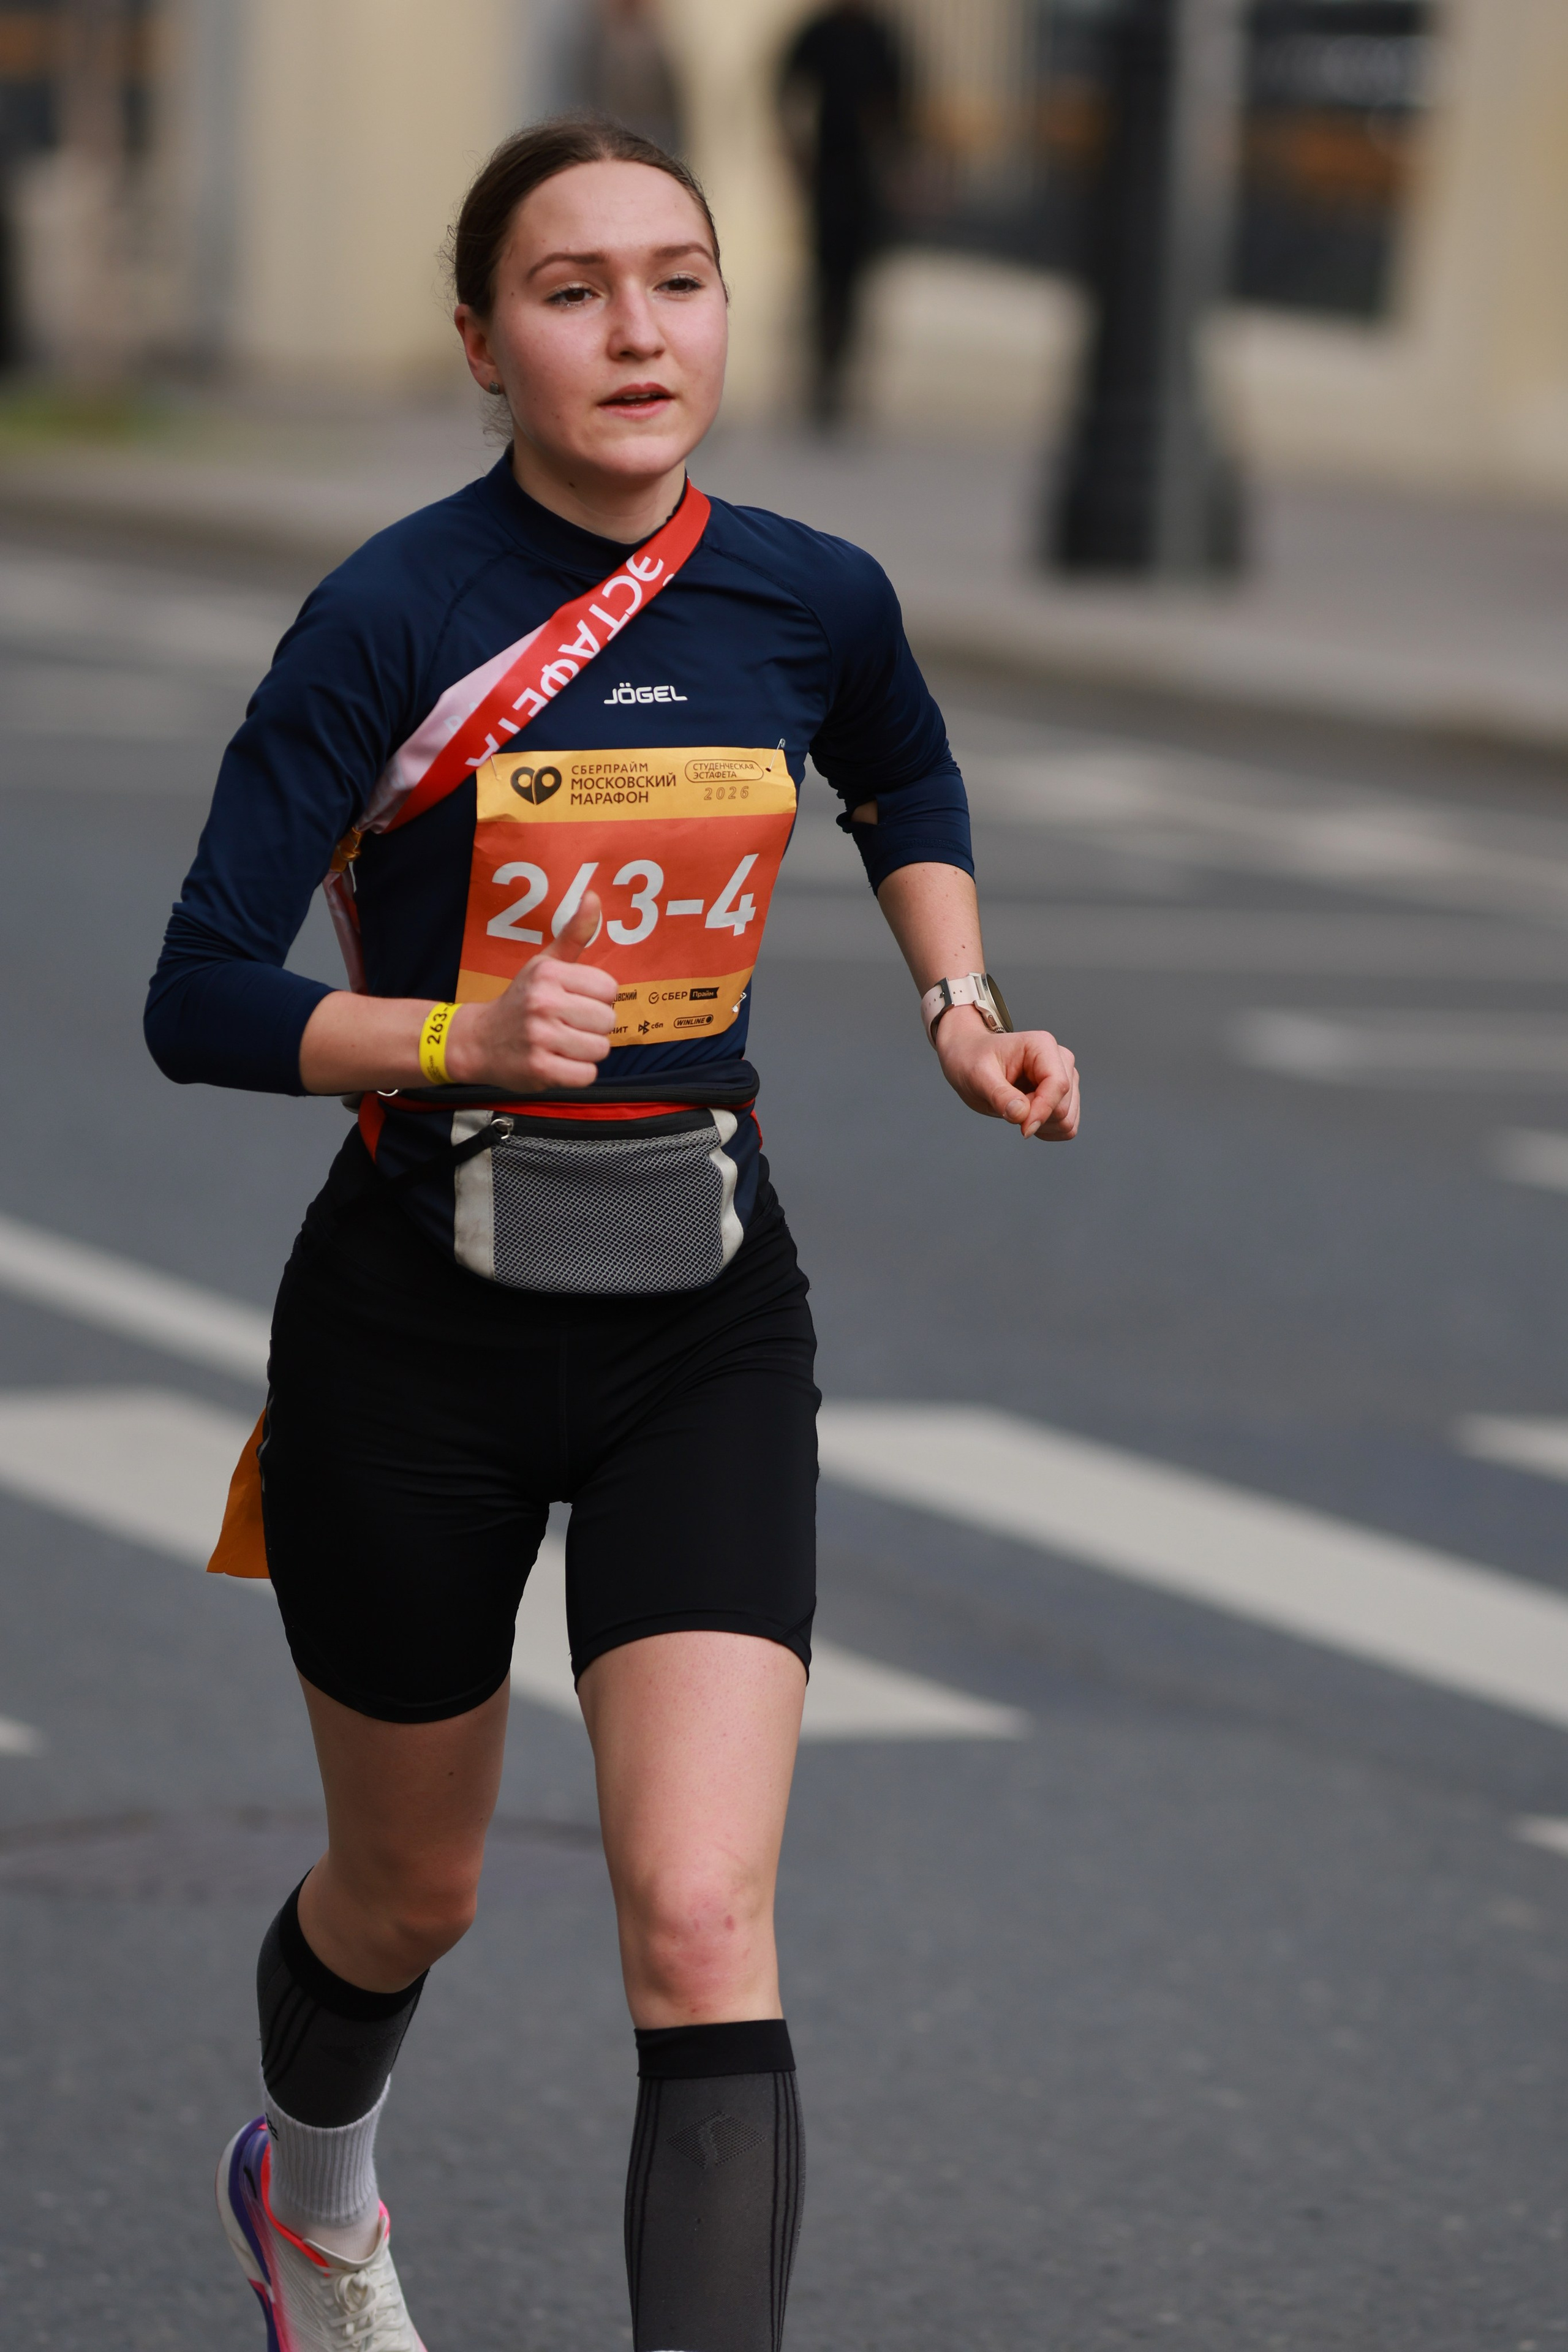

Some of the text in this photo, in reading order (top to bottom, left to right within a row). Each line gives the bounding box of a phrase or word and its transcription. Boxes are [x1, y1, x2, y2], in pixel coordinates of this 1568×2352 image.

[604, 682, 688, 704] JÖGEL
[571, 761, 649, 775] СБЕРПРАЙМ
[692, 762, 755, 772] СТУДЕНЧЕСКАЯ
[571, 772, 676, 790] МОСКОВСКИЙ
[692, 770, 737, 780] ЭСТАФЕТА
[570, 791, 649, 805] МАРАФОН
[704, 786, 749, 801] 2026
[486, 853, 759, 948] 263-4
[662, 991, 688, 1001] СБЕР
[426, 1003, 453, 1045] 263-
[676, 1017, 706, 1026] WINLINE
